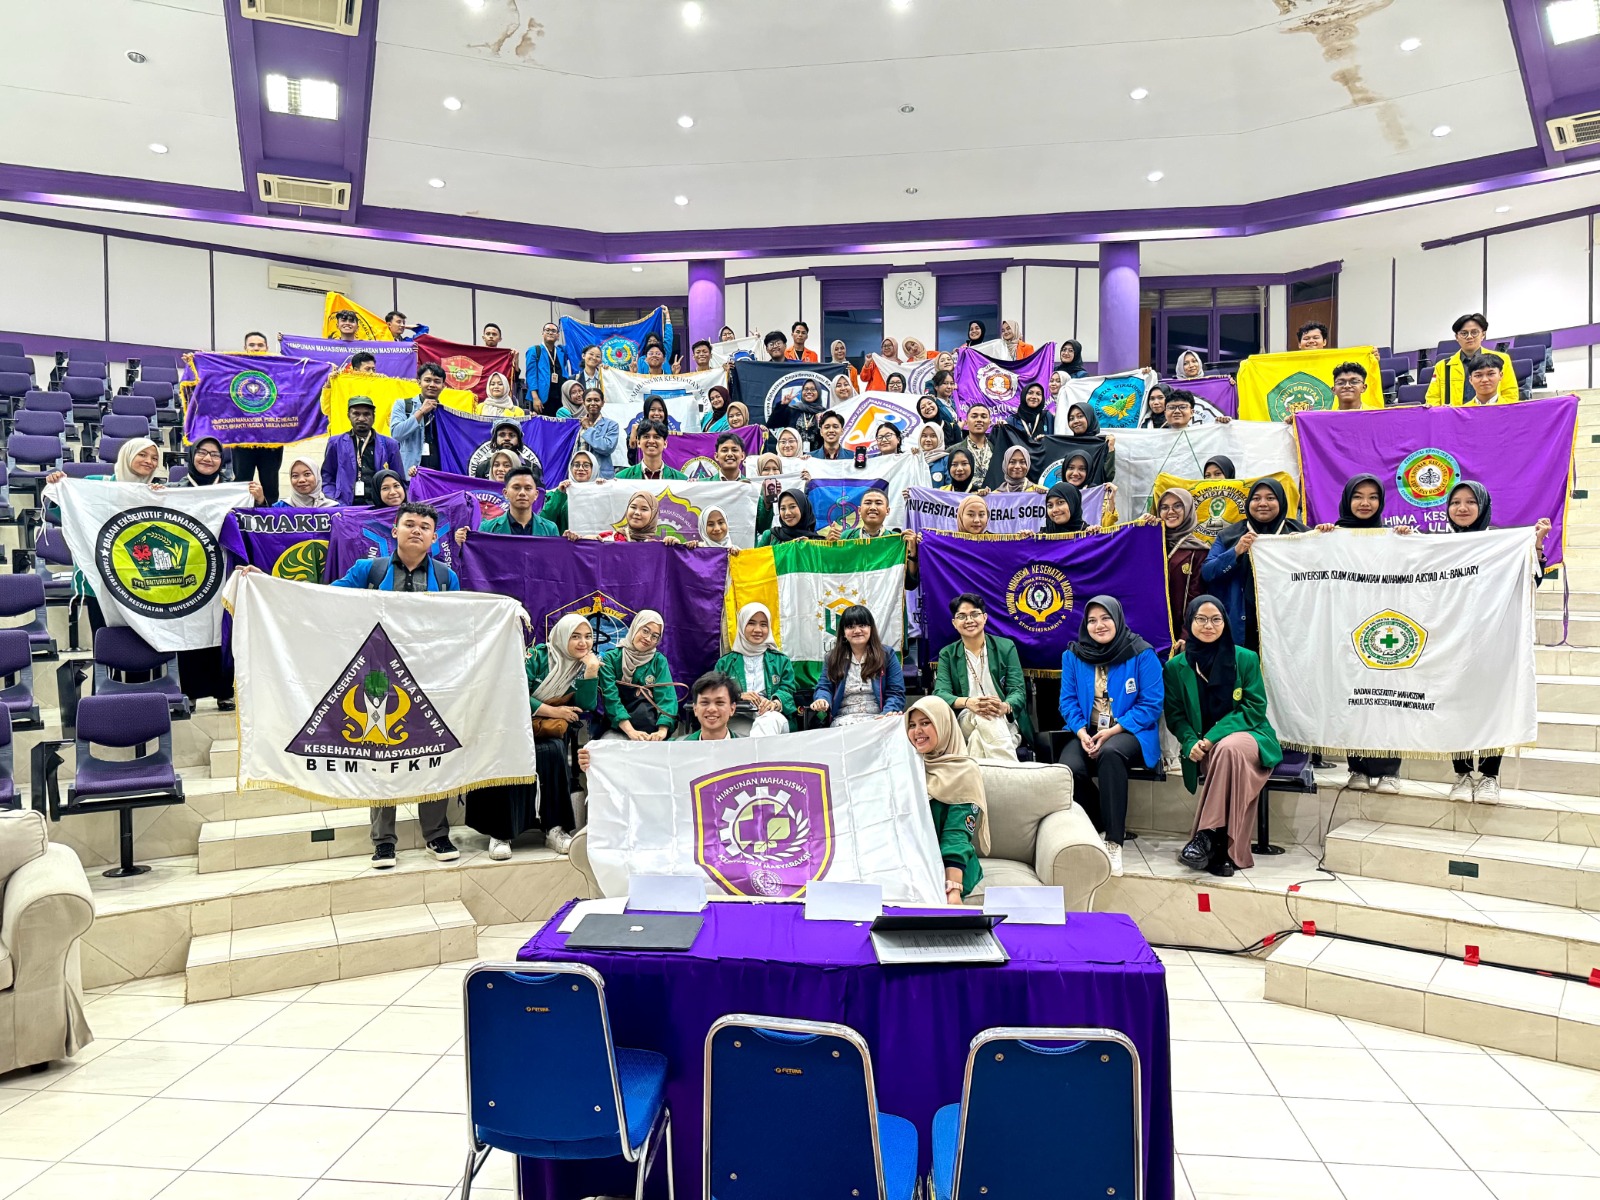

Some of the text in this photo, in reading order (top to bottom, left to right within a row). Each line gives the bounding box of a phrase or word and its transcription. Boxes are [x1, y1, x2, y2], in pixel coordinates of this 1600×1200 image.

[316, 345, 347, 353] MAHASISWA
[664, 375, 699, 390] KESEHATAN
[1280, 385, 1319, 402] UNIVERSITAS
[1202, 490, 1225, 499] CIPTA
[1384, 510, 1449, 525] HIMA KES
[102, 511, 211, 549] BADAN EKSEKUTIF MAHASISWA
[1031, 564, 1067, 582] KESEHATAN
[1330, 570, 1347, 581] ISLAM
[1381, 573, 1414, 584] MUHAMMAD
[1414, 571, 1438, 583] ARSYAD
[1439, 565, 1479, 581] AL-BANJARY
[102, 557, 164, 613] FAKULTAS ILMU KESEHATAN
[168, 552, 217, 613] UNIVERSITAS BAITURRAHMAN
[1018, 620, 1035, 632] STIKES
[306, 655, 367, 736] BADAN EKSEKUTIF
[389, 658, 445, 738] MAHASISWA
[1353, 688, 1371, 696] BADAN
[1371, 688, 1397, 698] EKSEKUTIF
[1348, 697, 1436, 711] FAKULTAS KESEHATAN MASYARAKAT
[304, 743, 446, 759] KESEHATAN MASYARAKAT
[715, 777, 807, 803] HIMPUNAN MAHASISWA
